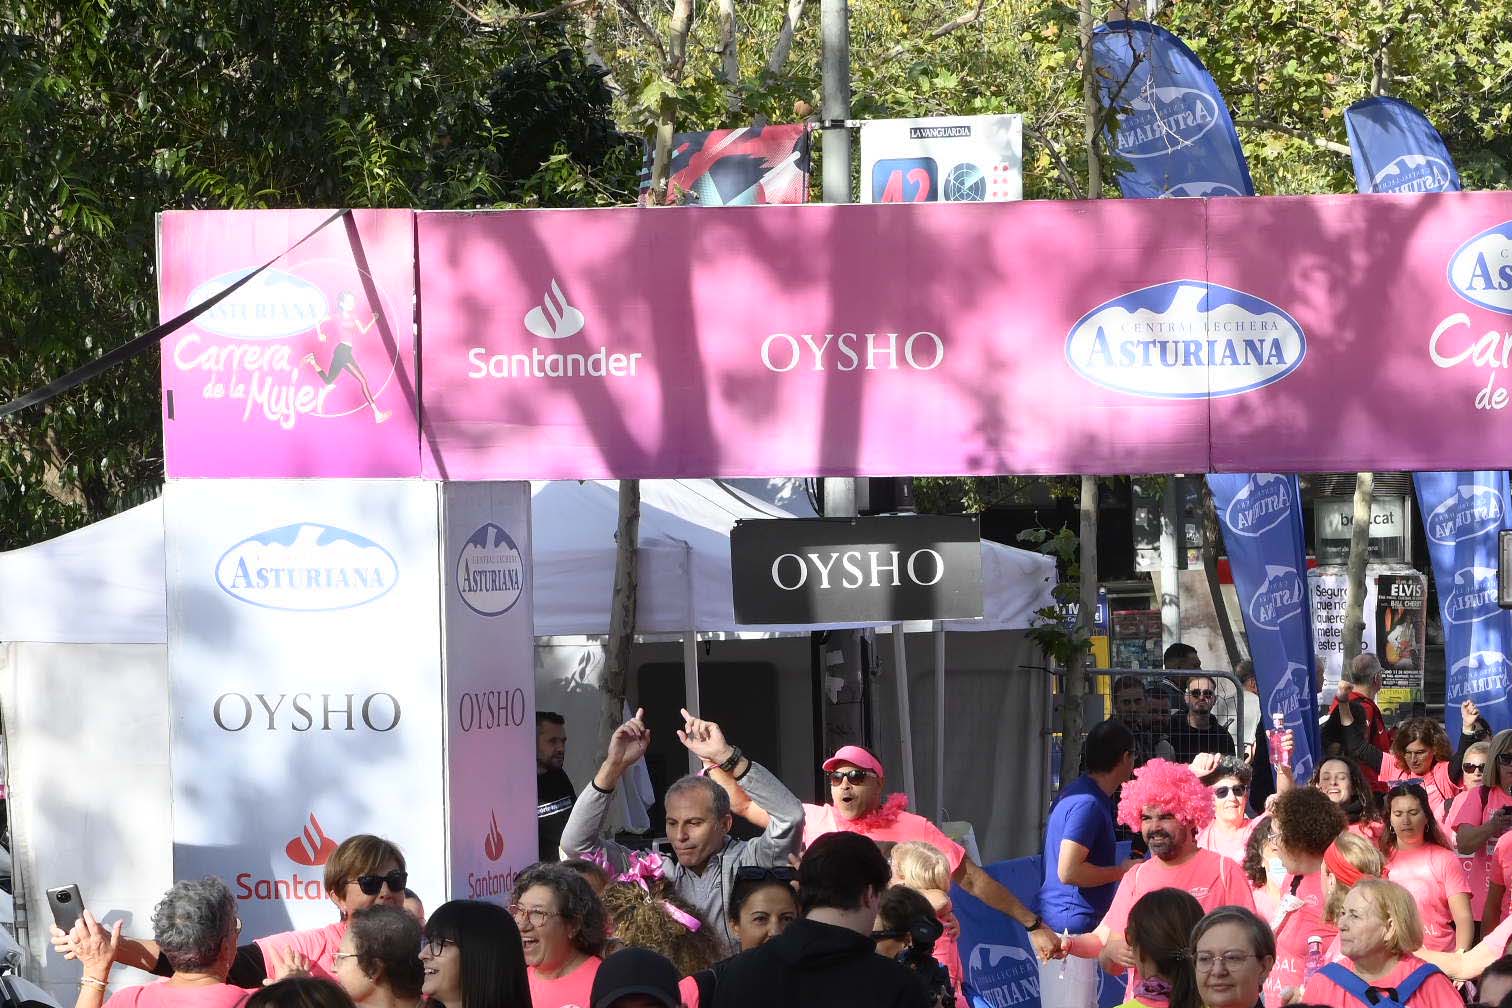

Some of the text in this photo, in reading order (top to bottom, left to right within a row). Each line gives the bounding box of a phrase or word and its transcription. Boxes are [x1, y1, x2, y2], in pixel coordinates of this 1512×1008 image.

[921, 127, 971, 137] VANGUARDIA
[1121, 320, 1279, 333] CENTRAL LECHERA
[172, 334, 292, 372] Carrera
[467, 346, 642, 379] Santander
[760, 331, 945, 372] OYSHO
[1086, 325, 1288, 368] ASTURIANA
[203, 371, 337, 430] de la Mujer
[1475, 372, 1509, 411] de
[229, 556, 386, 591] ASTURIANA
[462, 560, 520, 594] ASTURIANA
[771, 548, 945, 591] OYSHO
[1391, 584, 1422, 597] ELVIS
[212, 692, 402, 732] OYSHO
[459, 688, 526, 733] OYSHO
